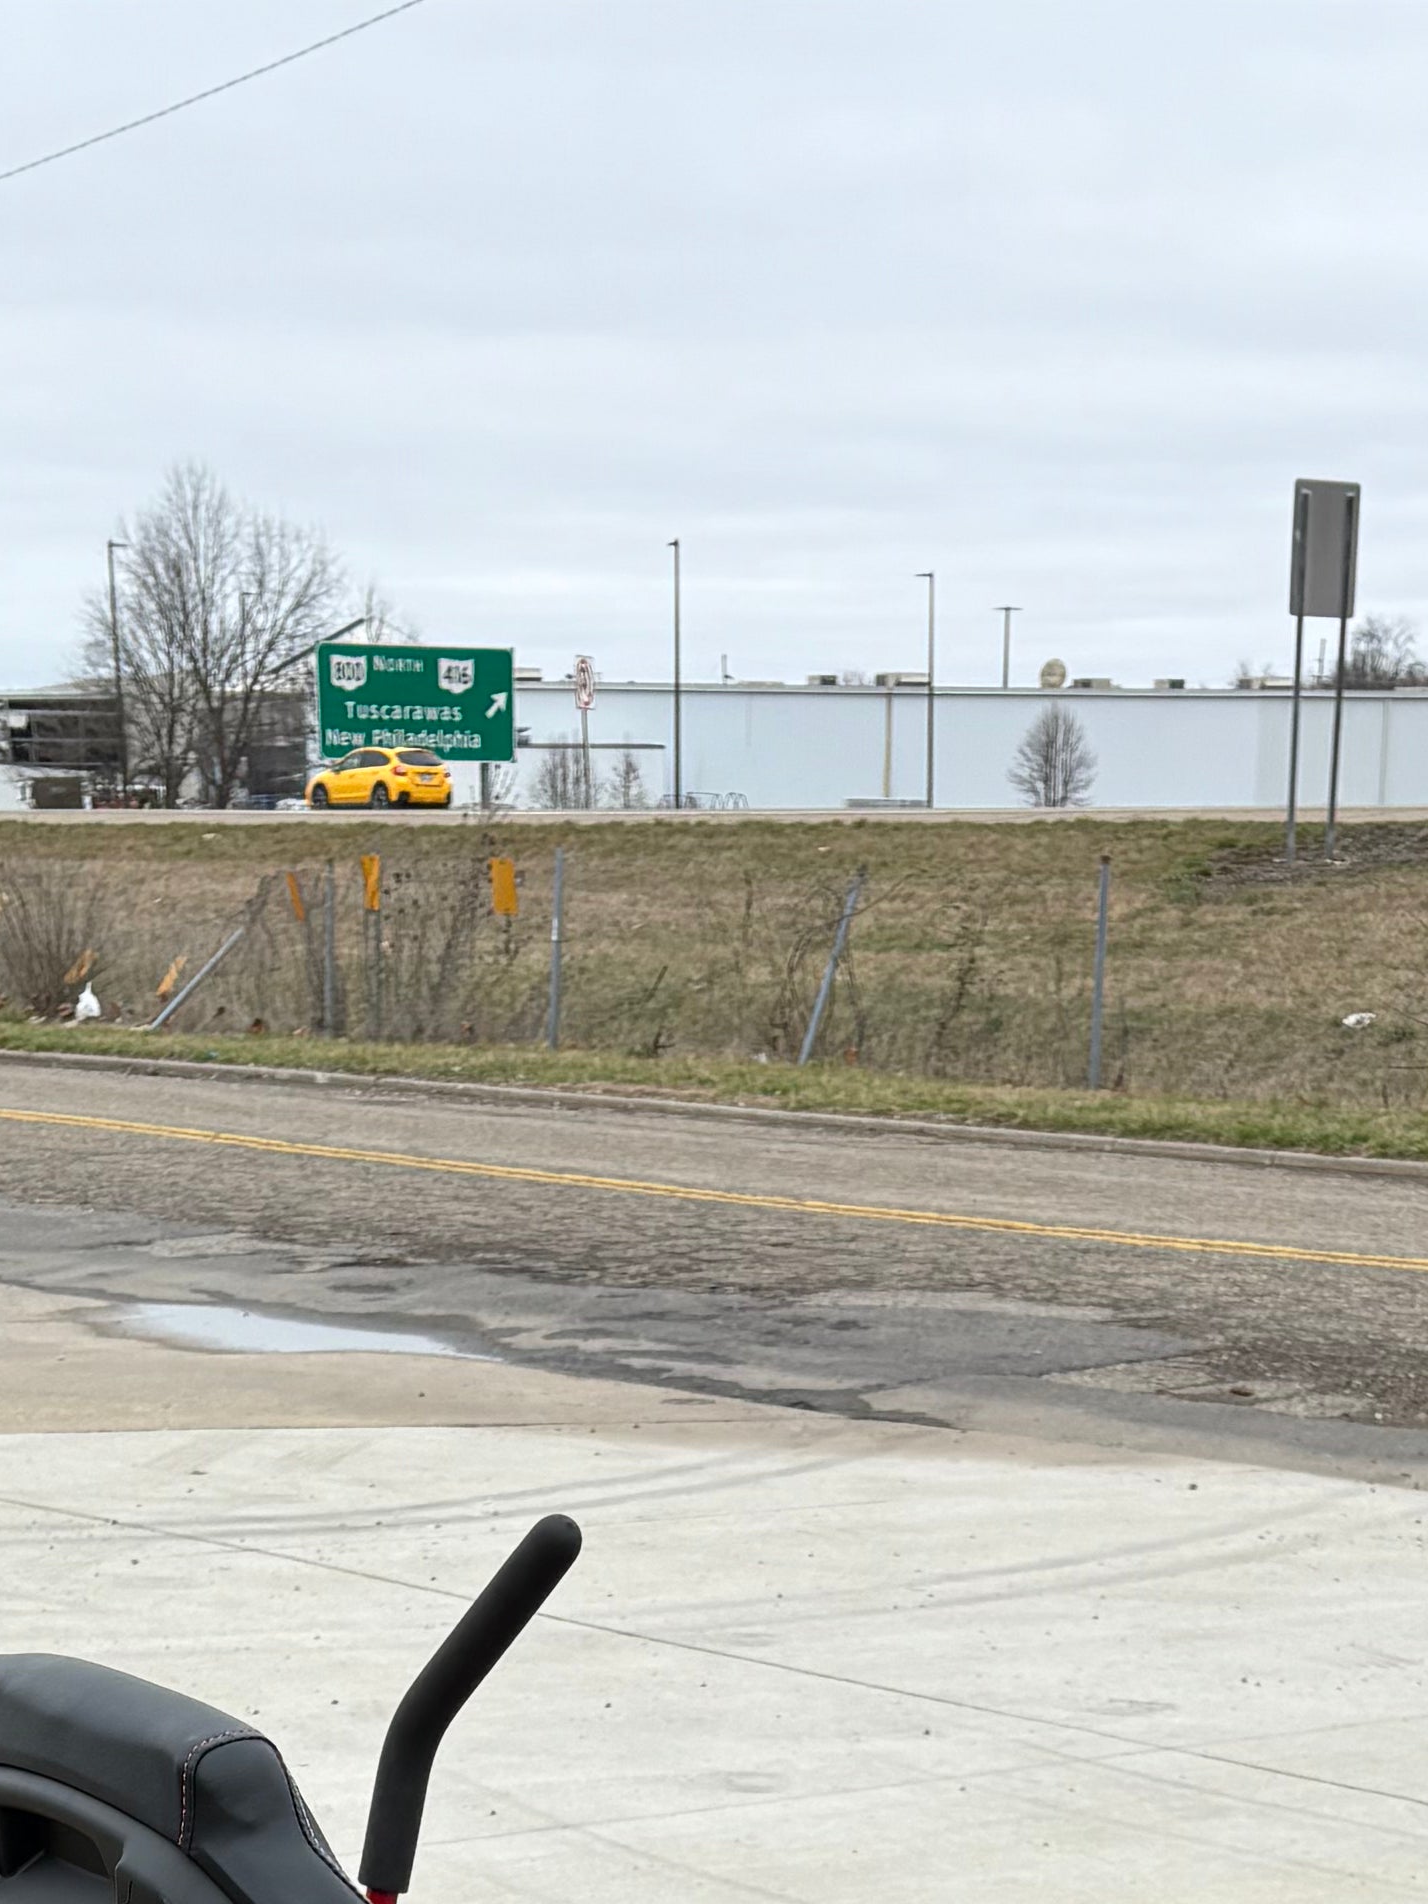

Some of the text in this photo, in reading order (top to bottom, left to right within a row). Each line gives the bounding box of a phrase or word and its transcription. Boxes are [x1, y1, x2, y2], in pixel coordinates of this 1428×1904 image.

[344, 701, 463, 722] Tuscarawas
[325, 728, 481, 751] New Philadelphia
